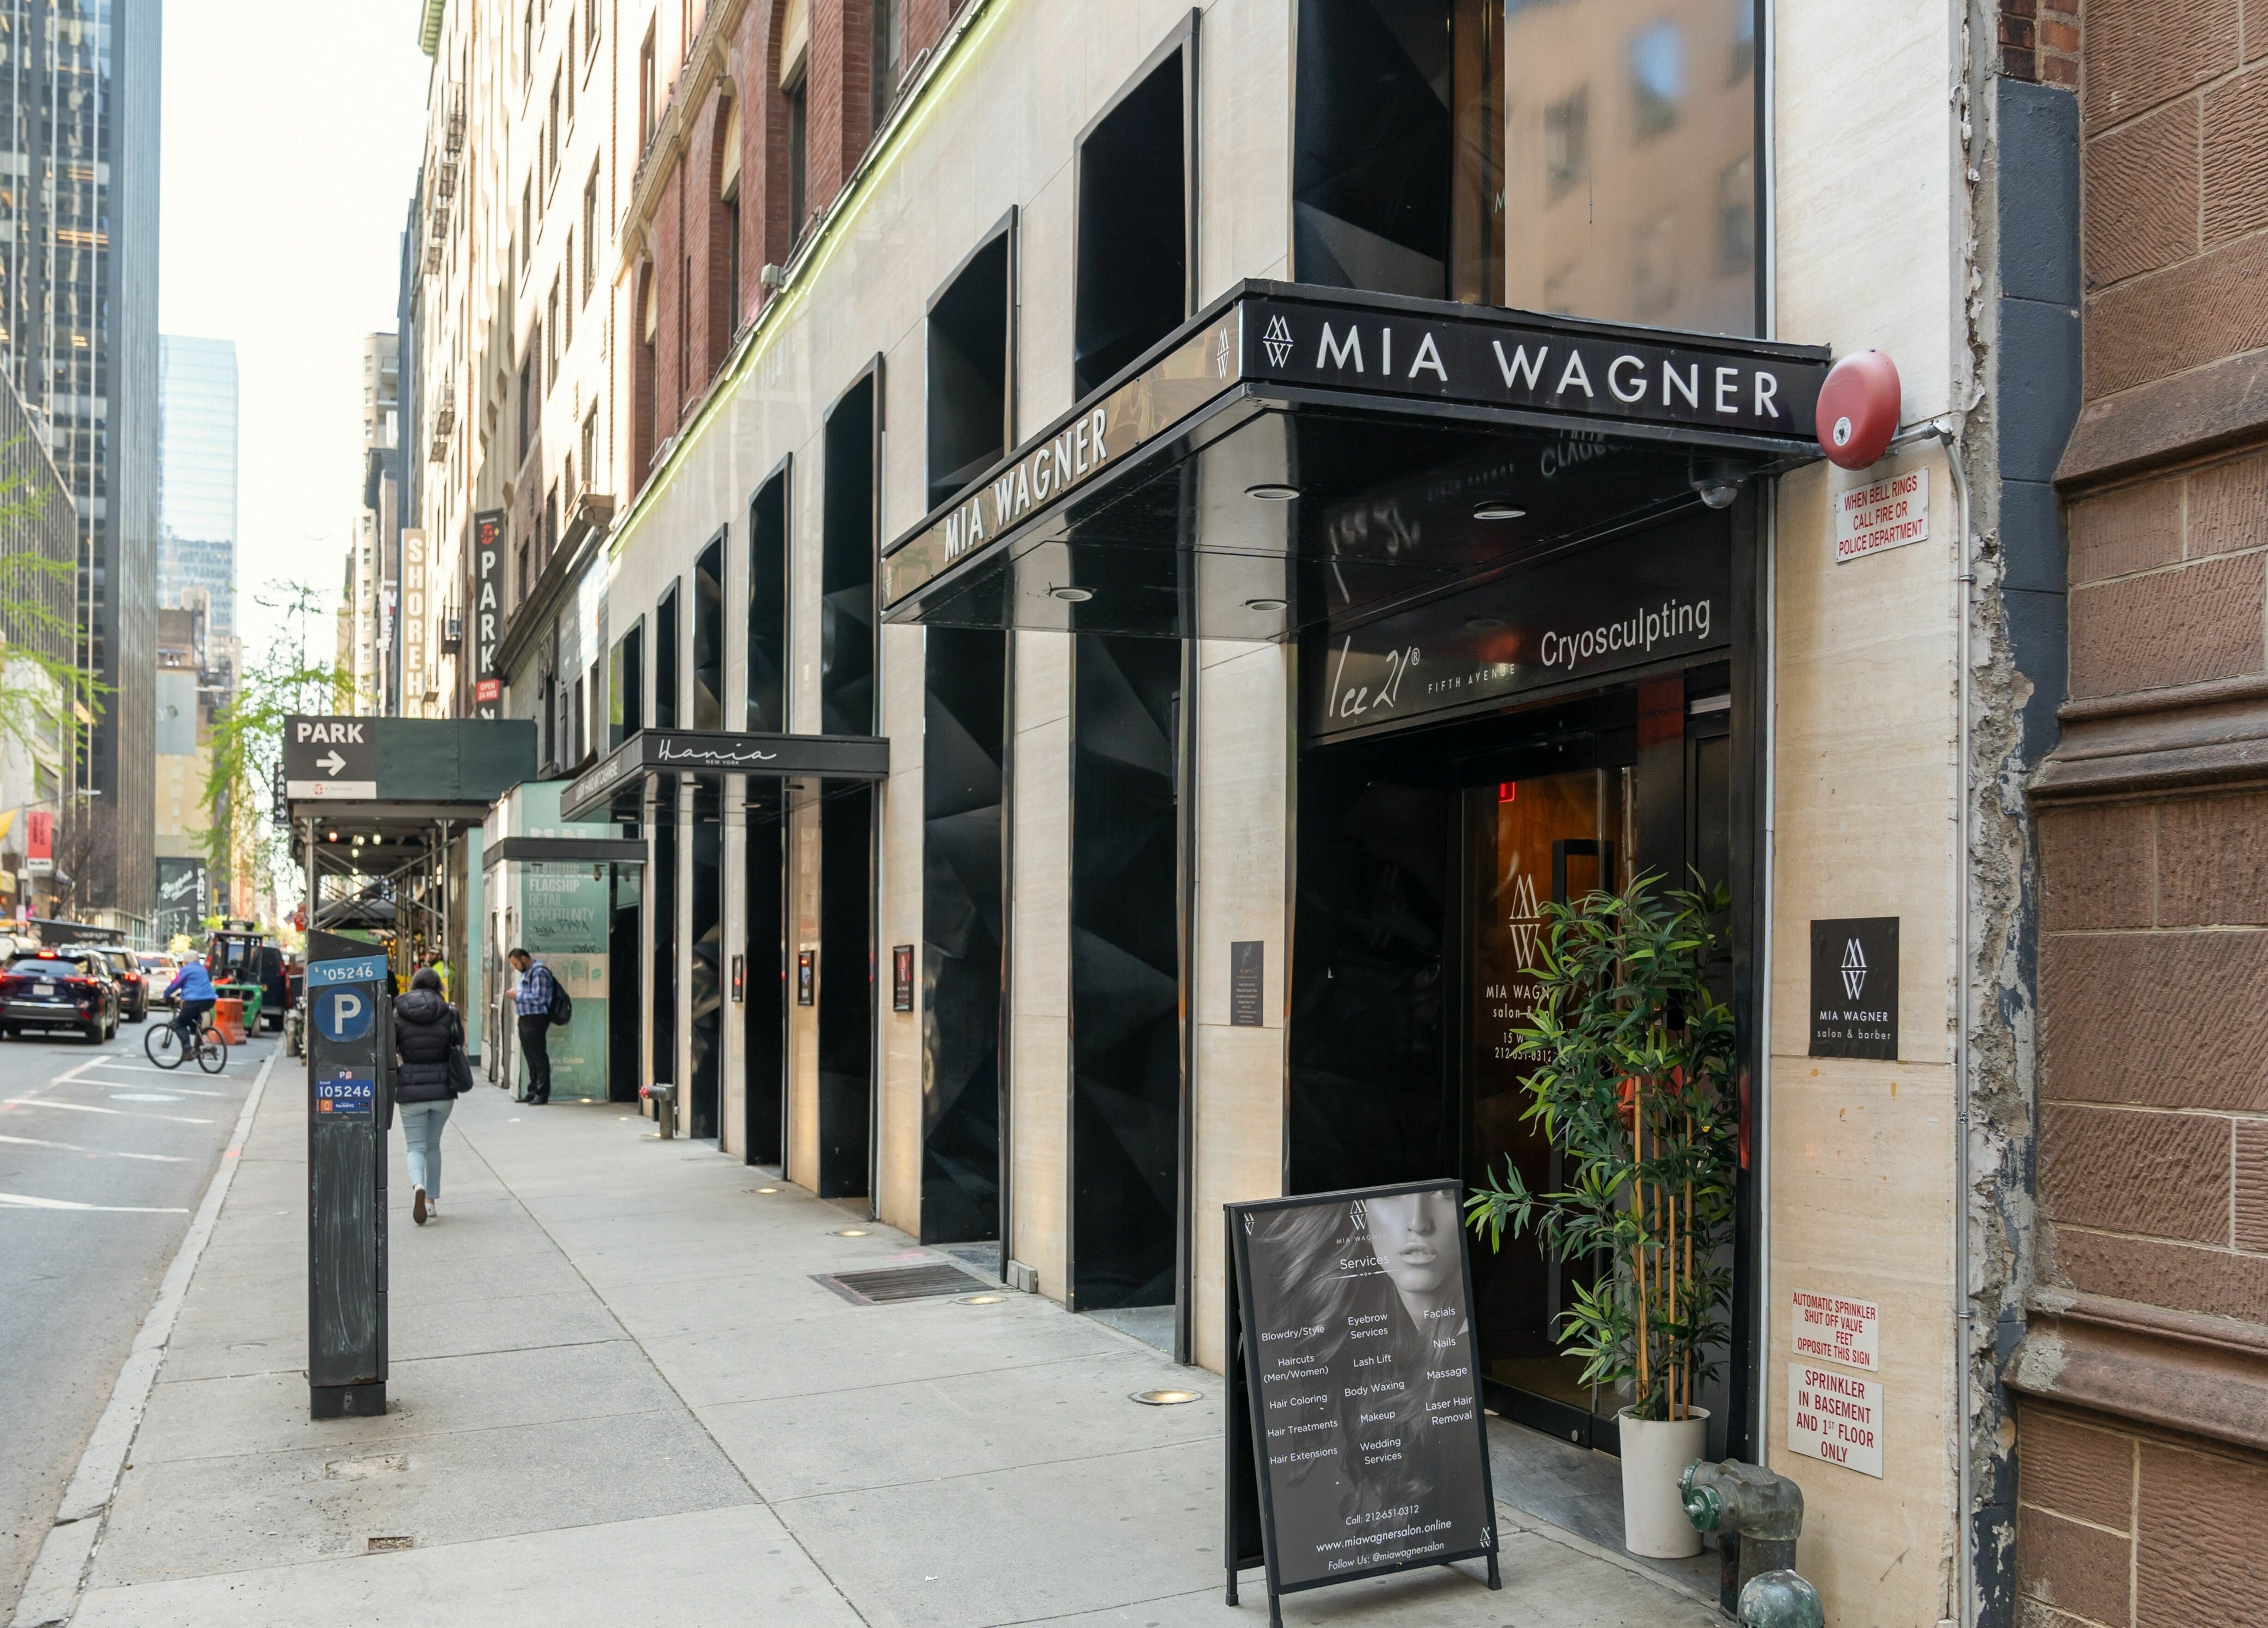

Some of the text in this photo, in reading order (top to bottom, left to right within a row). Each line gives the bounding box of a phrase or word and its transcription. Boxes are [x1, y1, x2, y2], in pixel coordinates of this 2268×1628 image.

[1316, 321, 1448, 382] MIA
[1493, 340, 1779, 418] WAGNER
[945, 409, 1107, 562] MIA WAGNER
[1844, 475, 1917, 512] WHEN BELL RINGS
[1853, 501, 1907, 530] CALL FIRE OR
[1839, 519, 1922, 556] POLICE DEPARTMENT
[479, 551, 497, 673] PARK
[408, 538, 423, 719] SHOREHA
[1540, 599, 1710, 670] Cryosculpting
[1428, 663, 1516, 695] FIFTH AVENUE
[297, 722, 364, 744] PARK
[658, 738, 777, 761] Hania
[276, 763, 285, 805] PARK
[530, 878, 579, 893] FLAGSHIP
[529, 893, 562, 907] RETAIL
[529, 908, 594, 922] OPPORTUNITY
[1486, 984, 1550, 999] MIA WAGN
[335, 994, 361, 1034] P
[1493, 1003, 1520, 1018] salon
[1820, 1011, 1888, 1023] MIA WAGNER
[1504, 1032, 1513, 1044] 15
[1817, 1028, 1892, 1040] salon & barber
[319, 1086, 371, 1097] 105246
[1340, 1253, 1390, 1270] Services
[1423, 1306, 1456, 1320] Facials
[1793, 1292, 1876, 1321] AUTOMATIC SPRINKLER
[1347, 1312, 1388, 1327] Eyebrow
[1804, 1309, 1863, 1333] SHUT OFF VALVE
[1261, 1325, 1325, 1342] Blowdry/Style
[1351, 1326, 1388, 1340] Services
[1836, 1331, 1853, 1346] FEET
[1433, 1336, 1456, 1349] Nails
[1797, 1337, 1871, 1366] OPPOSITE THIS SIGN
[1278, 1353, 1314, 1367] Haircuts
[1353, 1353, 1392, 1368] Lash Lift
[1263, 1365, 1329, 1383] (Men/Women)
[1427, 1366, 1468, 1381] Massage
[1344, 1380, 1405, 1399] Body Waxing
[1805, 1369, 1865, 1400] SPRINKLER
[1269, 1393, 1328, 1410] Hair Coloring
[1425, 1395, 1472, 1412] Laser Hair
[1798, 1390, 1871, 1424] IN BASEMENT
[1360, 1410, 1396, 1424] Makeup
[1432, 1410, 1472, 1427] Removal
[1267, 1419, 1338, 1438] Hair Treatments
[1796, 1412, 1874, 1449] AND 1ST FLOOR
[1360, 1438, 1402, 1453] Wedding
[1821, 1441, 1847, 1464] ONLY
[1270, 1447, 1338, 1465] Hair Extensions
[1364, 1451, 1402, 1466] Services
[1345, 1504, 1419, 1526] Call: 212-651-0312
[1316, 1518, 1452, 1554] www.miawagnersalon.online
[1328, 1541, 1445, 1571] Follow Us: @miawagnersalon
